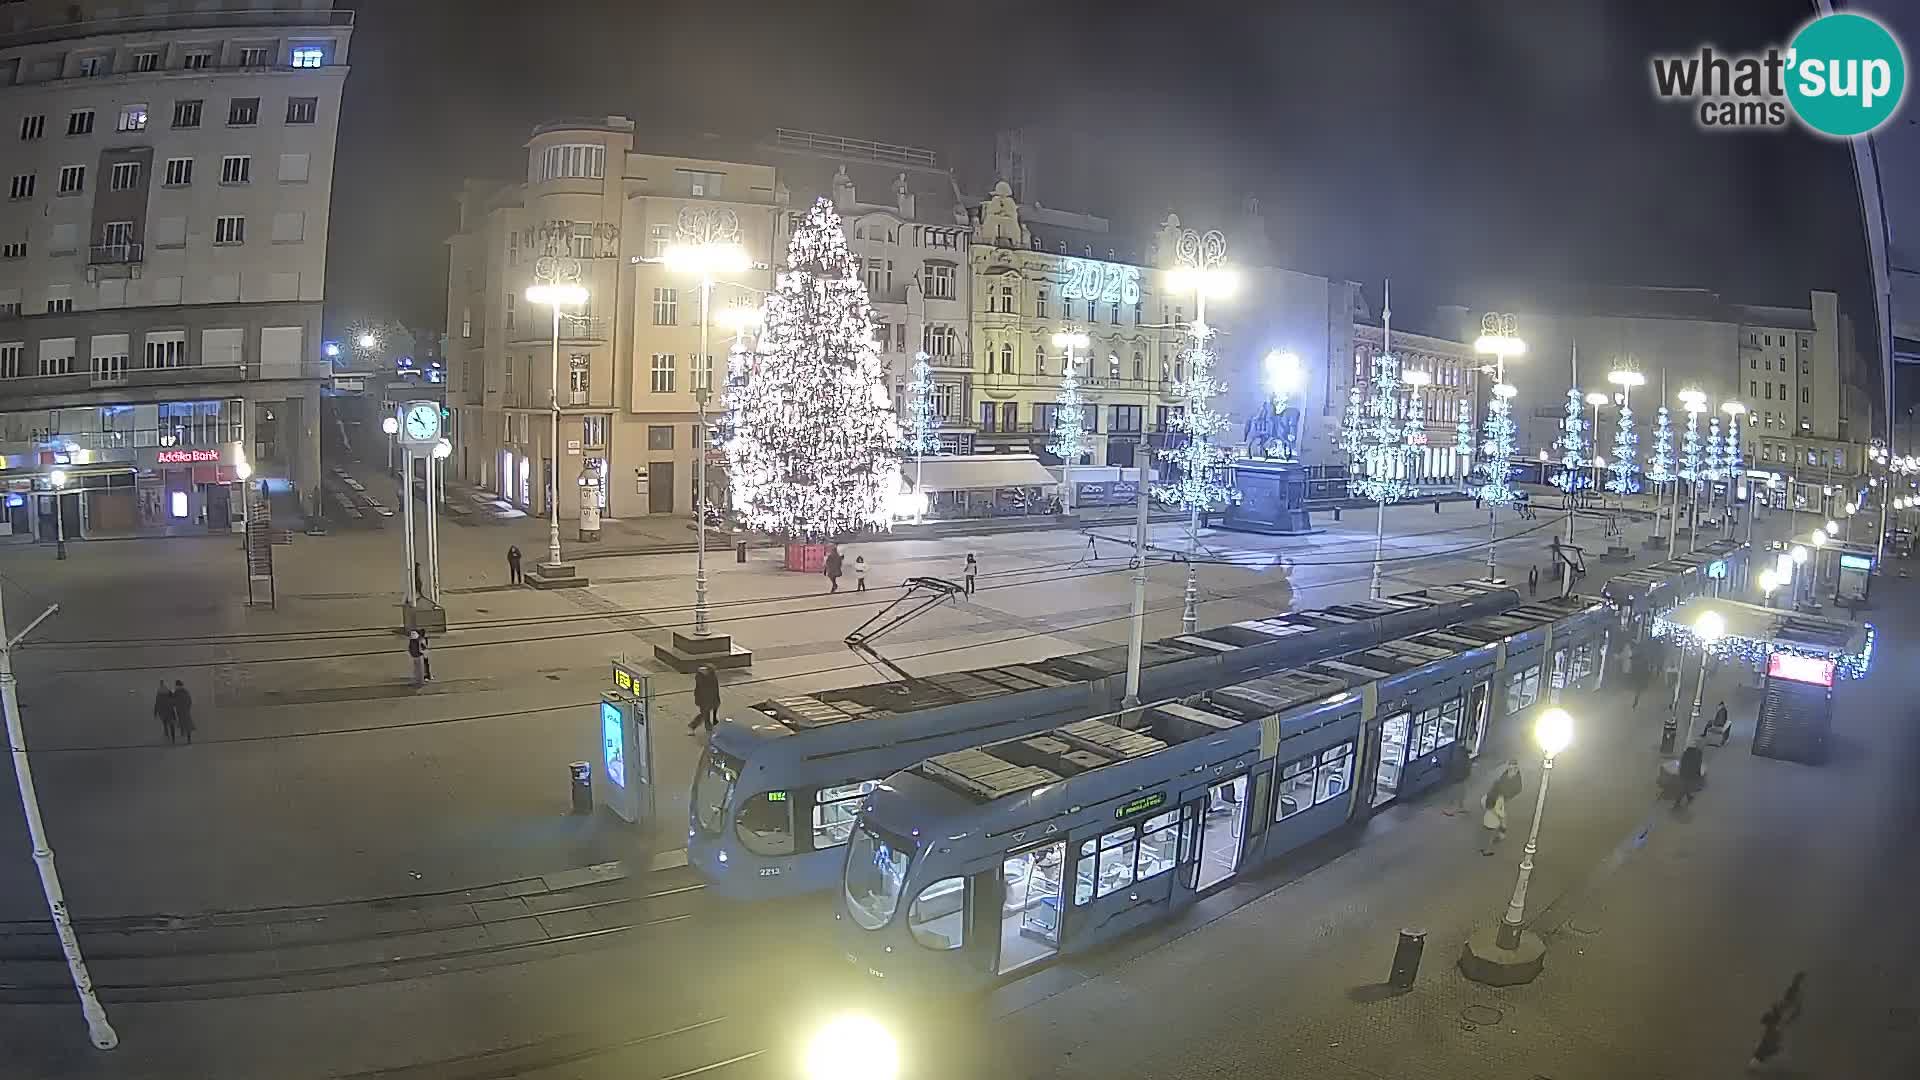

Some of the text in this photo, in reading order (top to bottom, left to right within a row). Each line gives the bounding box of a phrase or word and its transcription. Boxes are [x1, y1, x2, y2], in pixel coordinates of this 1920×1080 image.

[1062, 259, 1140, 305] 2026
[158, 449, 219, 463] Addiko Bank
